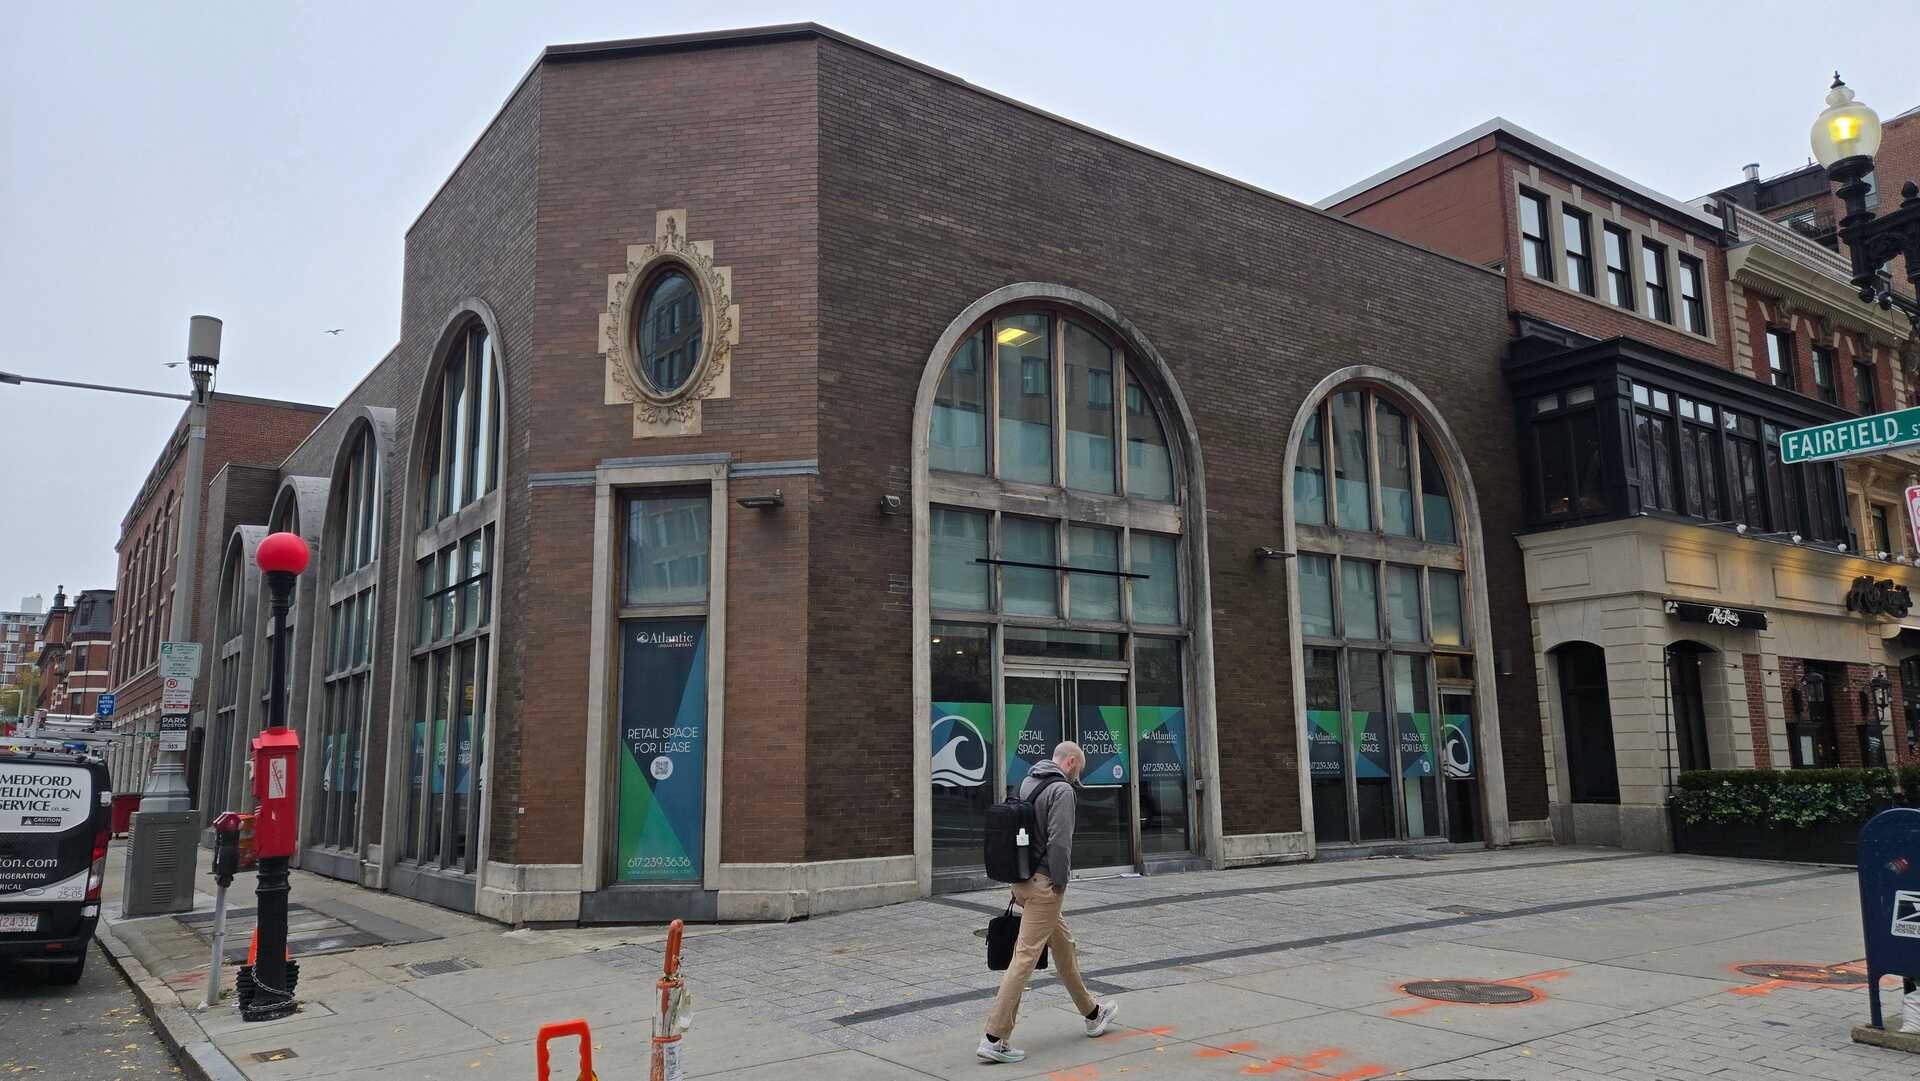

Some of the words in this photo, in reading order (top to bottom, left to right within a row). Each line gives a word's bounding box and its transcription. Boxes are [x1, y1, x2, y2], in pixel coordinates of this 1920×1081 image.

[1788, 417, 1899, 459] FAIRFIELD
[649, 631, 693, 644] Atlantic
[627, 728, 660, 740] RETAIL
[662, 726, 699, 739] SPACE
[1018, 730, 1044, 741] RETAIL
[1084, 730, 1110, 741] 14,356
[1111, 730, 1120, 740] SF
[1150, 730, 1177, 740] Atlantic
[634, 742, 657, 754] FOR
[660, 741, 691, 753] LEASE
[1018, 744, 1046, 755] SPACE
[1082, 744, 1098, 754] FOR
[1100, 743, 1122, 754] LEASE
[1361, 744, 1380, 753] SPACE
[1401, 744, 1413, 752] FOR
[0, 774, 72, 787] MEDFORD
[0, 787, 81, 800] ELLINGTON
[627, 856, 691, 868] 617.239.3636
